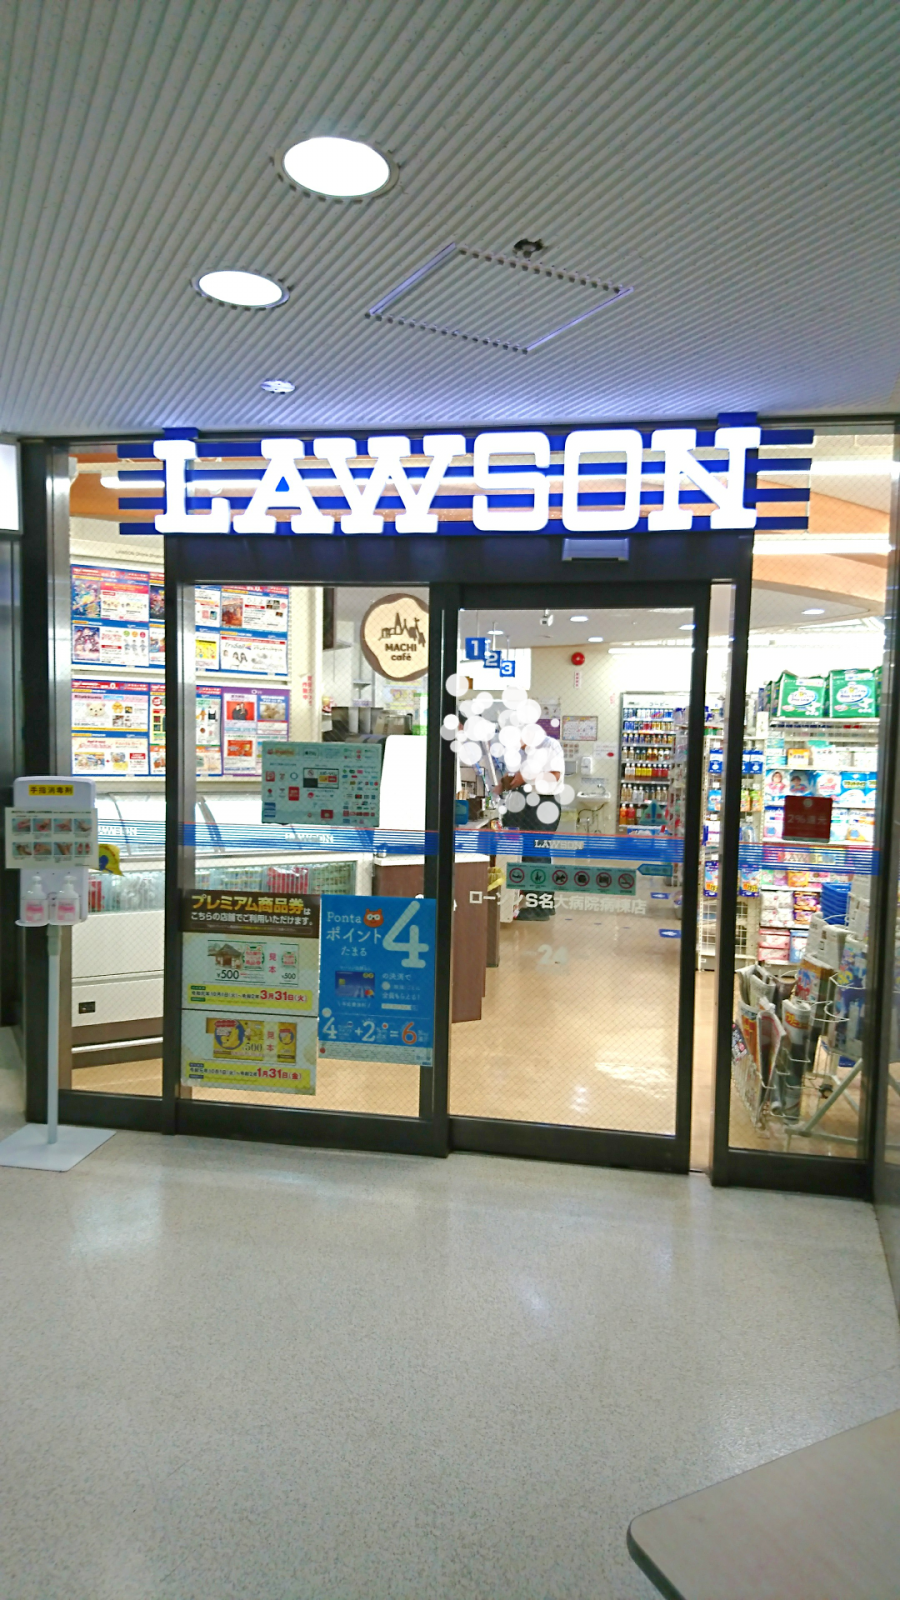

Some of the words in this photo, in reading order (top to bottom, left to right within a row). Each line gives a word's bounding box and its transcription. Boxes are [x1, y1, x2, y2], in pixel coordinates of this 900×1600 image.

[153, 426, 761, 534] LAWSON
[385, 643, 417, 652] MACHI
[471, 640, 478, 656] 1
[391, 653, 412, 661] café
[485, 653, 498, 667] 2
[501, 662, 513, 675] 3
[30, 786, 73, 794] 手指消毒剤
[534, 839, 584, 850] LAWSON
[192, 894, 311, 916] プレミアム商品券は
[191, 912, 313, 926] こちらの店舗でご利用いただけます。
[327, 912, 361, 923] Ponta
[326, 926, 381, 944] ポイント
[382, 900, 429, 969] 4
[341, 946, 367, 957] たまる
[217, 970, 239, 979] ¥500
[322, 1016, 337, 1039] 4
[362, 1021, 375, 1042] 2
[402, 1021, 417, 1045] 6
